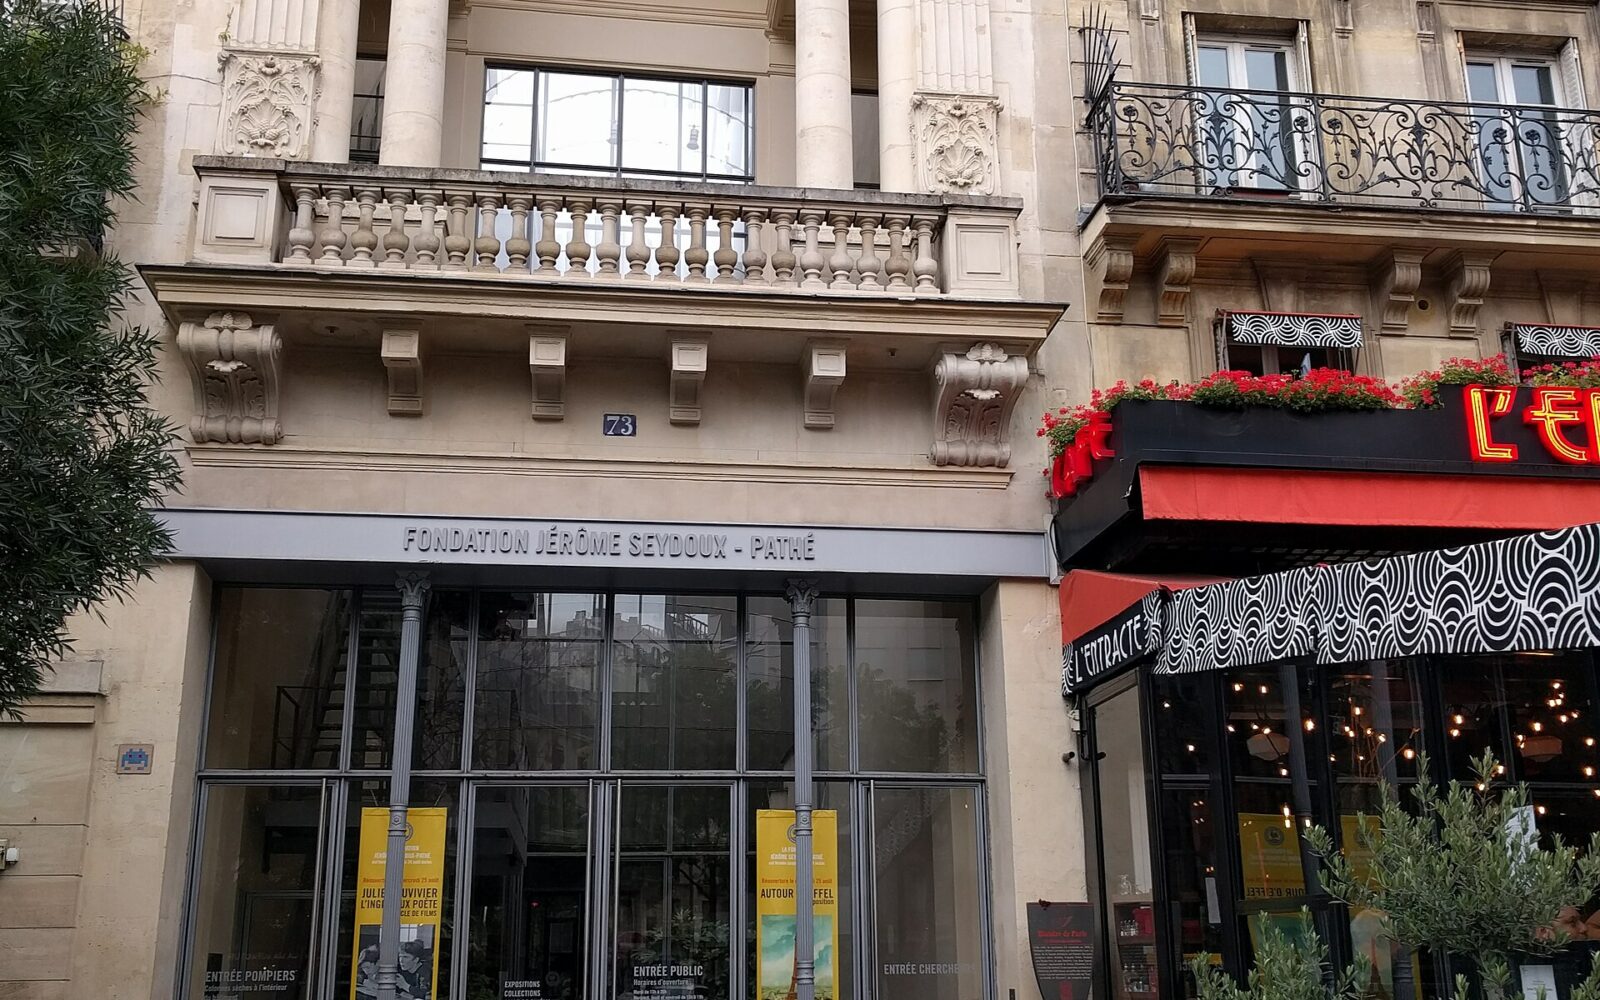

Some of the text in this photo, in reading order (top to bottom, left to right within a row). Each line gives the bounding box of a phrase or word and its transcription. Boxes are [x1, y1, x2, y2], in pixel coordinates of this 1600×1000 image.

[606, 415, 633, 435] 73
[402, 526, 530, 554] FONDATION
[535, 525, 621, 556] JÉRÔME
[629, 531, 726, 559] SEYDOUX
[750, 531, 816, 561] PATHÉ
[1074, 613, 1143, 683] L'ENTRACTE
[362, 888, 438, 898] JULIE UVIVIER
[761, 888, 834, 899] AUTOUR FFEL
[413, 897, 438, 909] POÈTE
[812, 898, 835, 906] position
[633, 964, 703, 977] ENTRÉE PUBLIC
[883, 962, 976, 975] ENTRÉE CHERCHE
[205, 969, 296, 983] ENTRÉE POMPIERS
[633, 978, 657, 986] Horaires
[504, 980, 541, 988] EXPOSITIONS
[504, 989, 541, 997] COLLECTIONS
